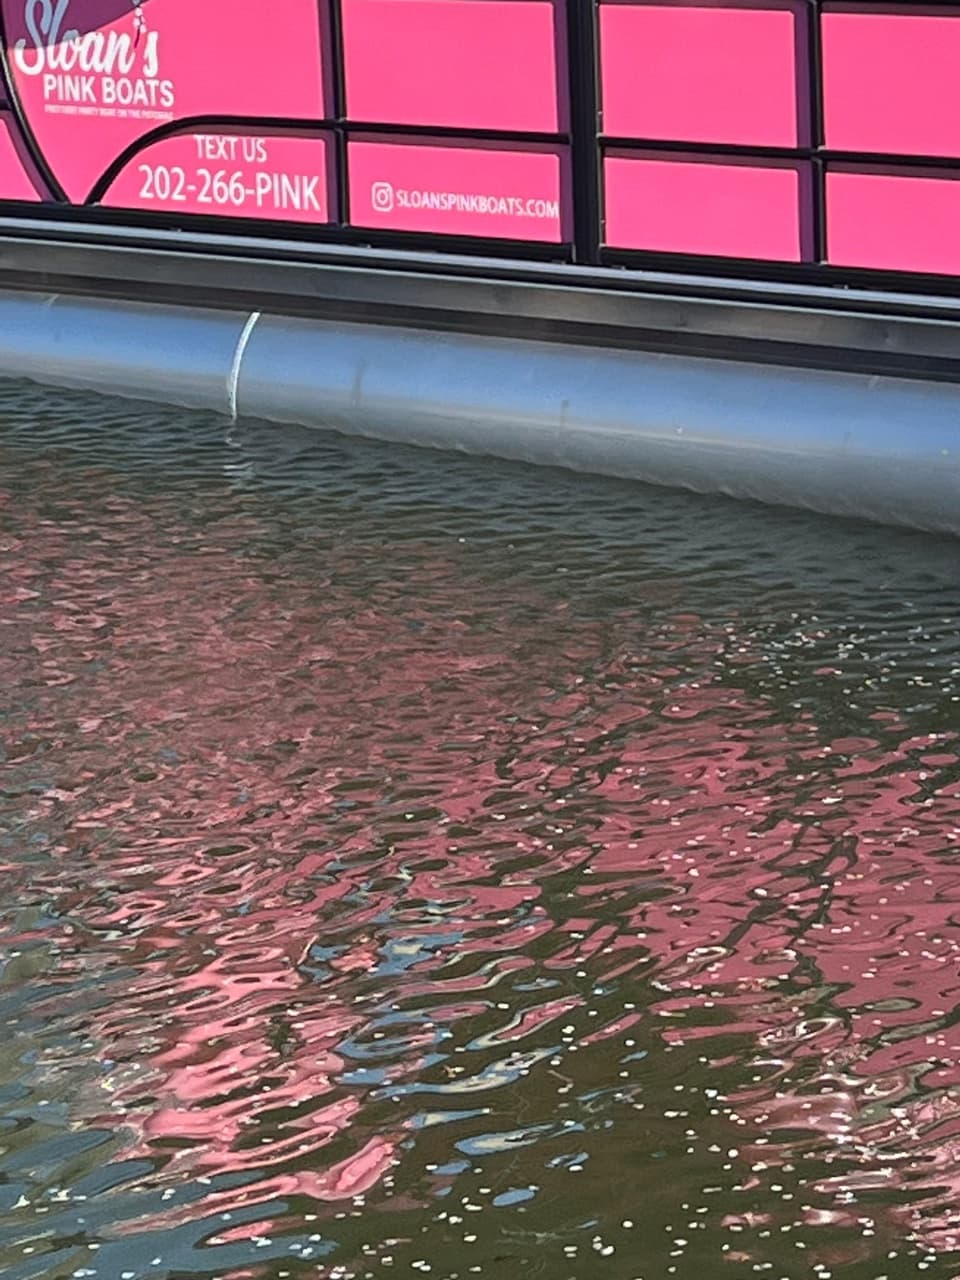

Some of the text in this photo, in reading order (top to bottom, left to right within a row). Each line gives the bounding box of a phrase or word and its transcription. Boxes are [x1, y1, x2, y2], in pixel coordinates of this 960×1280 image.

[43, 74, 174, 107] PINK BOATS
[193, 135, 268, 163] TEXT US
[139, 164, 321, 211] 202-266-PINK
[396, 189, 560, 218] SLOANSPINKBOATS.COM
